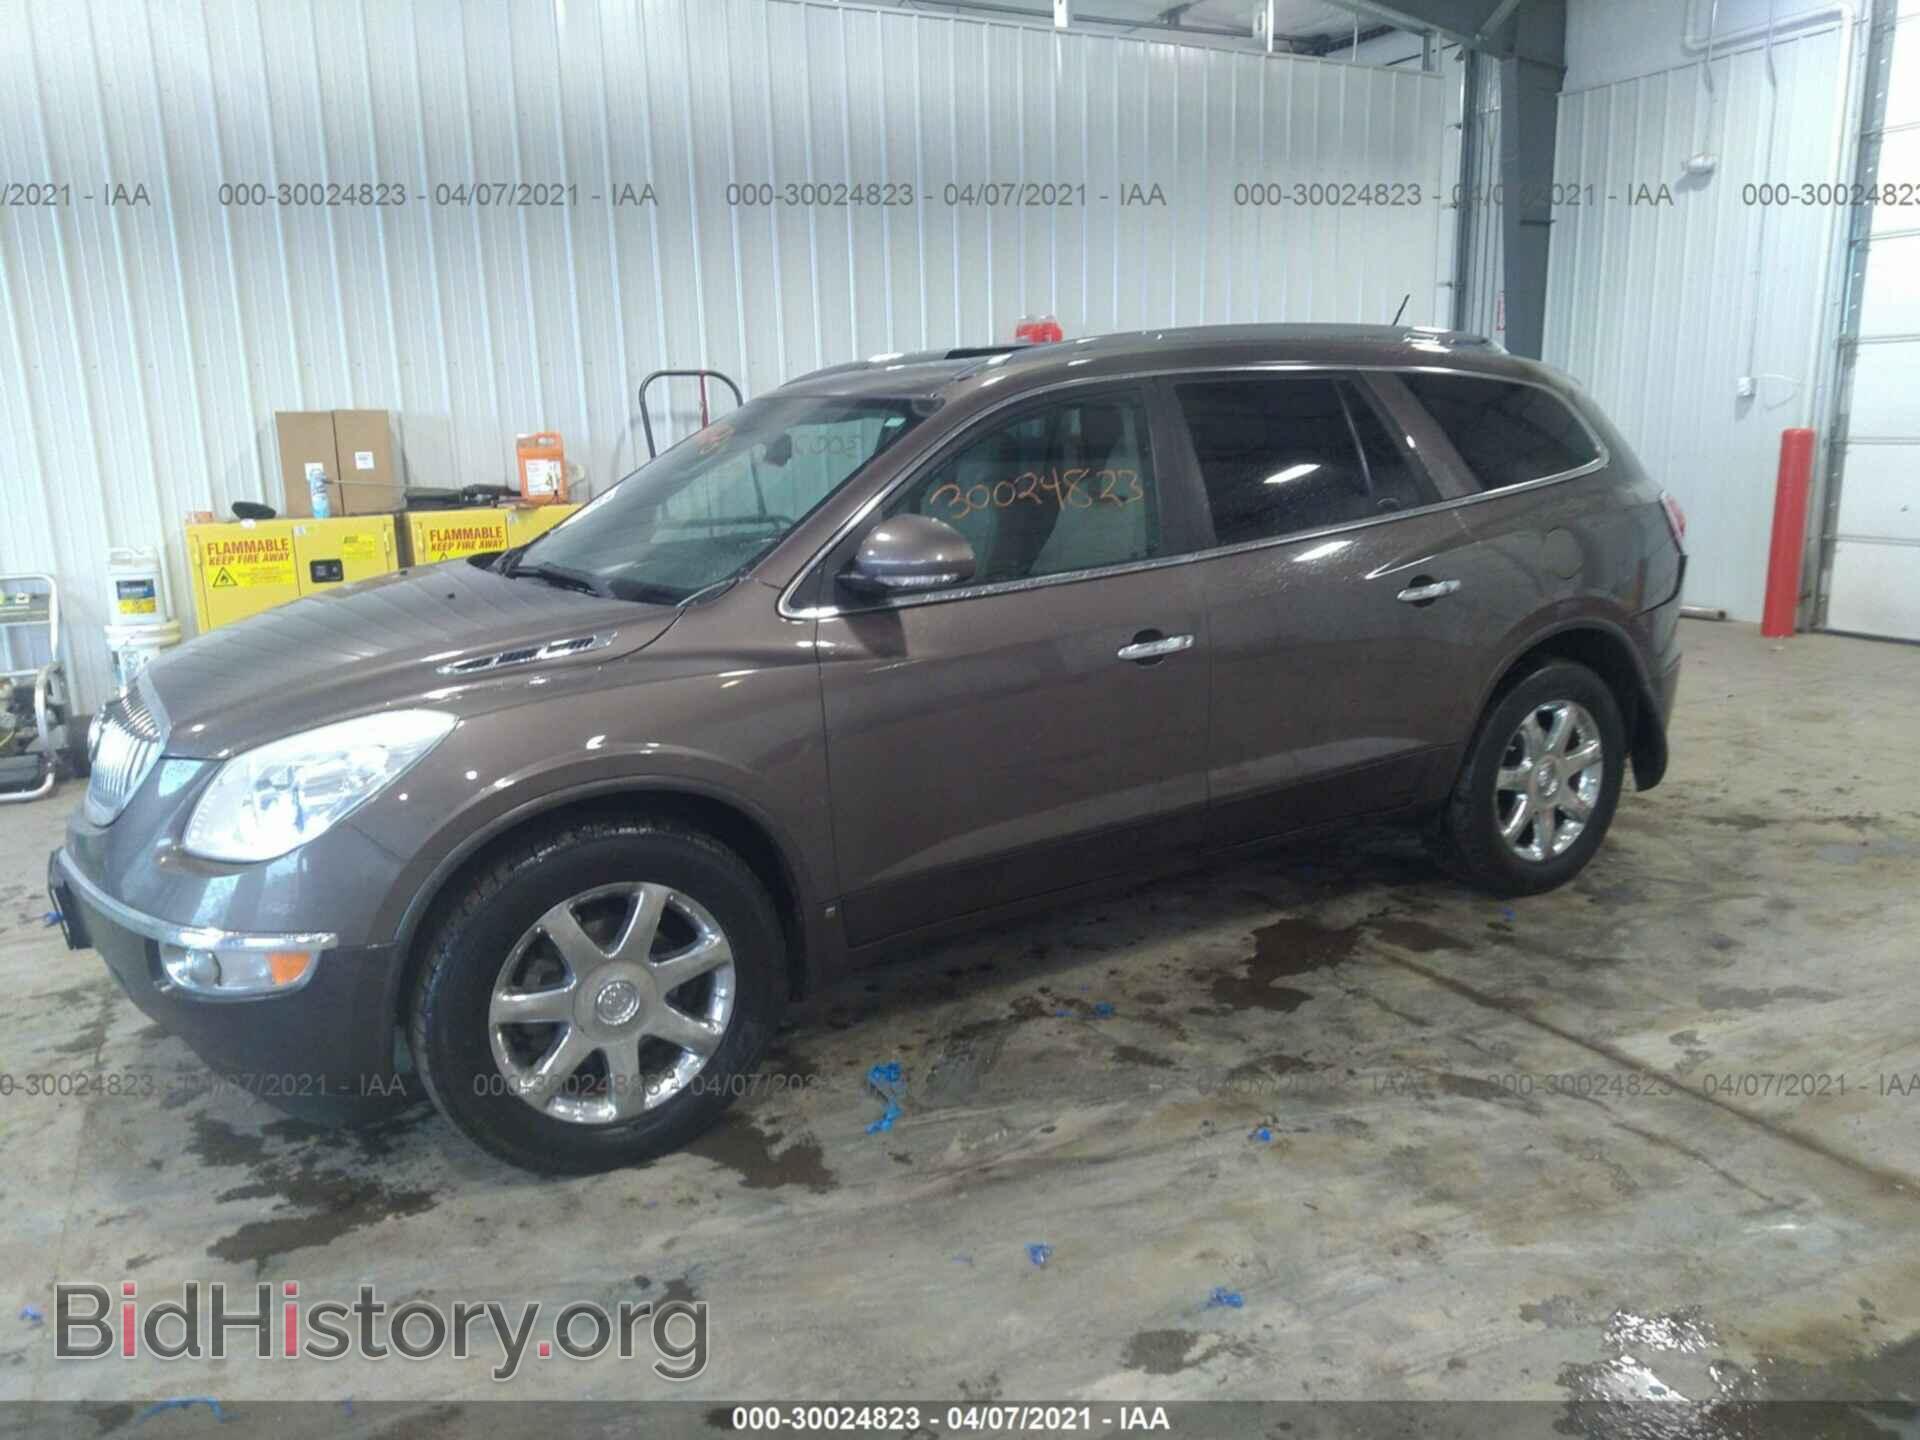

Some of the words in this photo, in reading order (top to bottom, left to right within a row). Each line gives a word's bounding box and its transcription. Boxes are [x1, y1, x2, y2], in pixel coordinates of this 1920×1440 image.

[930, 468, 1144, 518] 30024823
[429, 526, 503, 542] FLAMMABLE
[207, 538, 289, 556] FLAMMABLE
[431, 541, 455, 552] KEEP
[456, 540, 477, 551] FIRE
[478, 539, 504, 550] AWAY
[208, 555, 235, 567] KEEP
[237, 553, 259, 565] FIRE
[262, 551, 290, 563] AWAY
